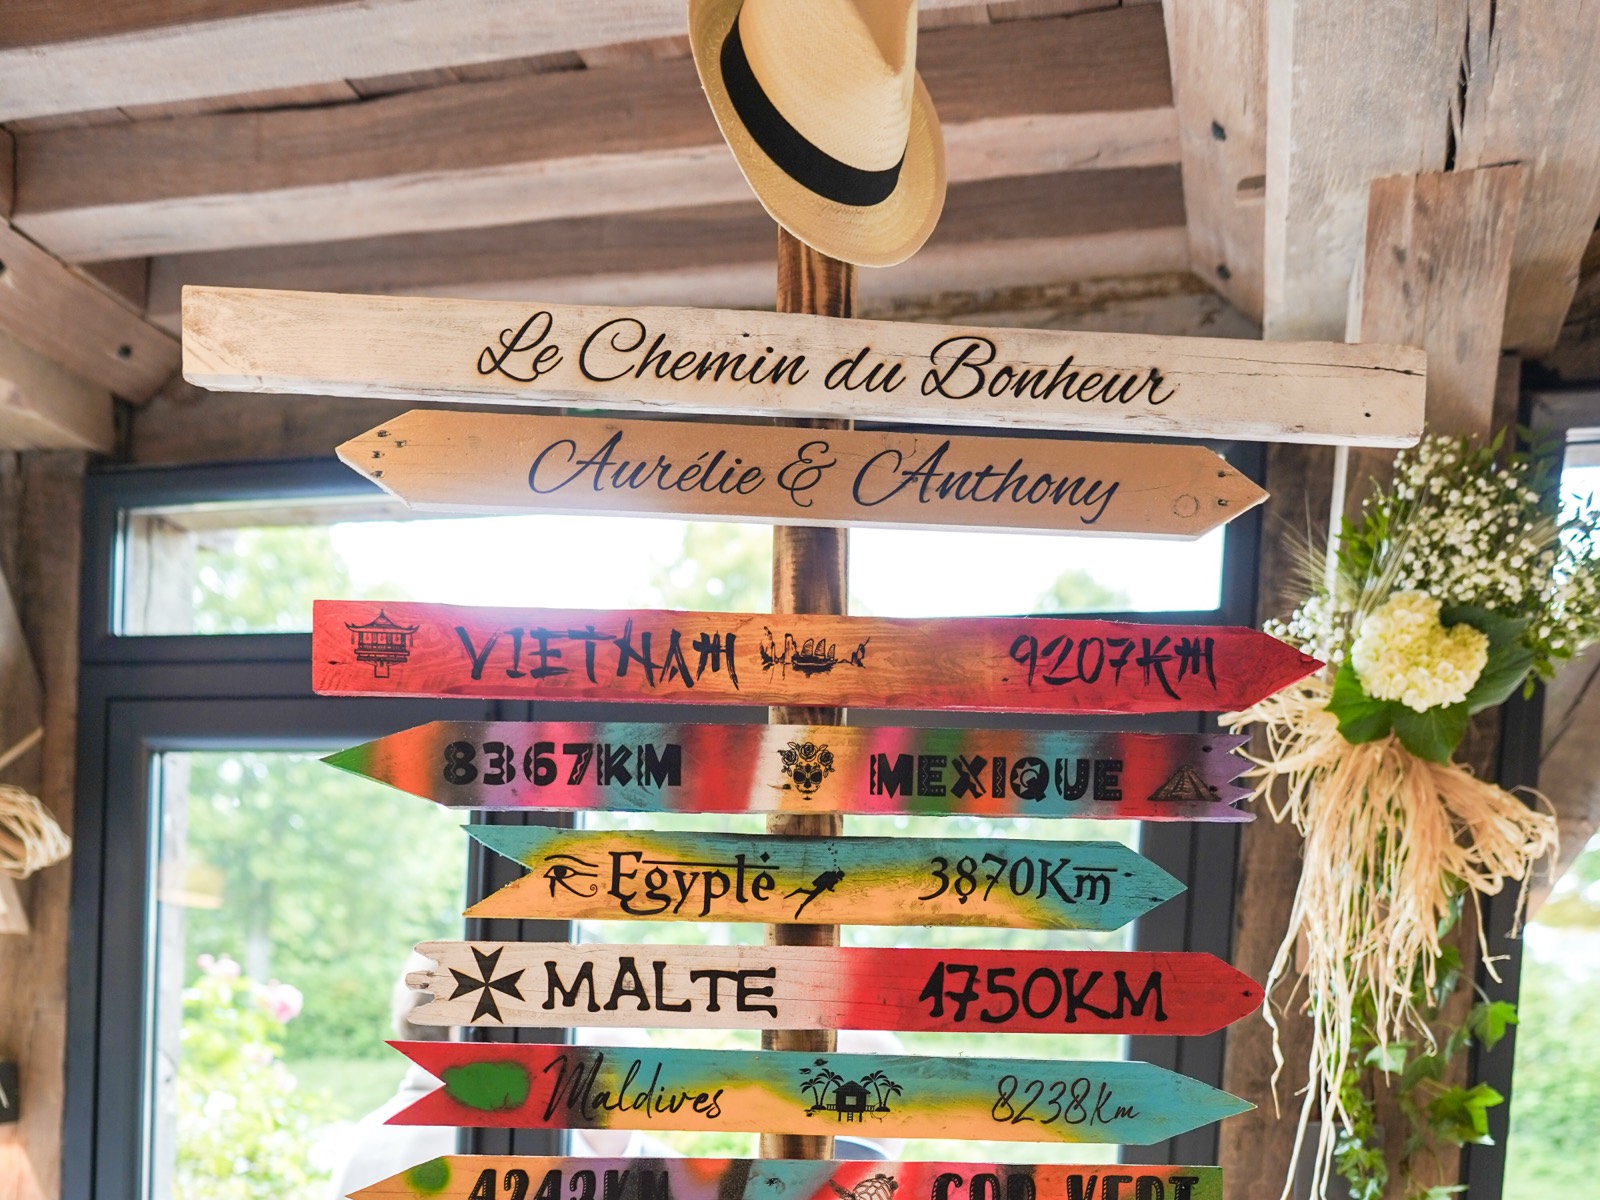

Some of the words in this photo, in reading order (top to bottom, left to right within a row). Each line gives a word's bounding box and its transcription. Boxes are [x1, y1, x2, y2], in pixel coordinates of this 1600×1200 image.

[477, 311, 562, 382] Le
[579, 318, 809, 385] Chemin
[825, 347, 906, 393] du
[921, 335, 1175, 405] Bonheur
[528, 430, 766, 495] Aurélie
[777, 441, 837, 507] &
[853, 440, 1120, 524] Anthony
[455, 617, 740, 691] VIETNAM
[1010, 635, 1216, 699] 9207KM
[443, 742, 682, 787] 8367KM
[870, 753, 1123, 802] MEXIQUE
[918, 853, 1118, 905] 3870Km
[542, 957, 778, 1018] MALTE
[919, 961, 1167, 1023] 1750KM
[543, 1054, 722, 1122] Maldives
[991, 1074, 1140, 1125] 8238Km
